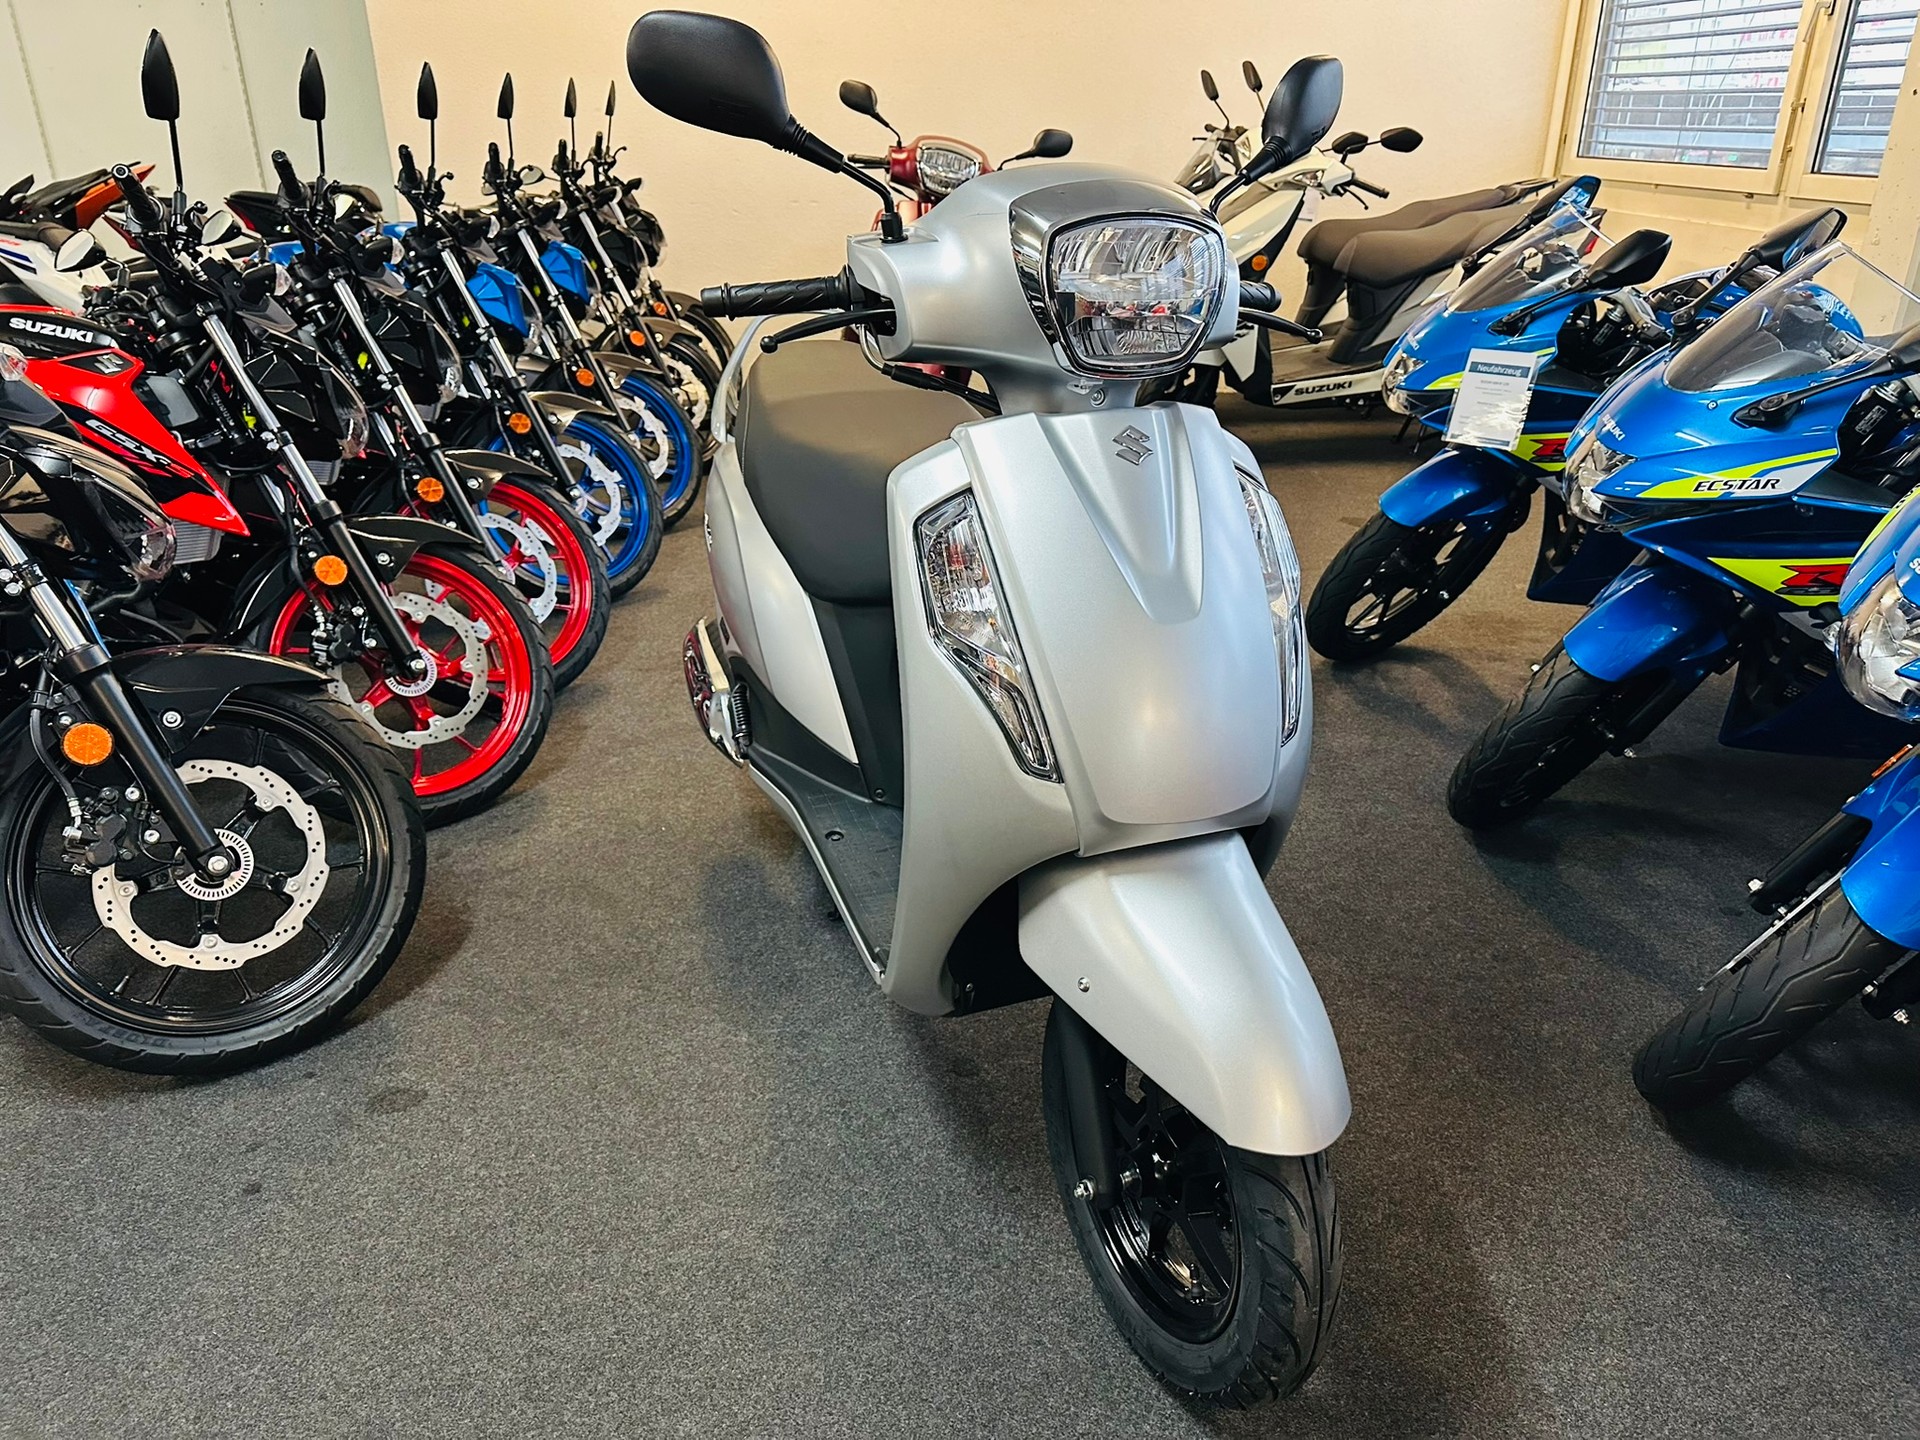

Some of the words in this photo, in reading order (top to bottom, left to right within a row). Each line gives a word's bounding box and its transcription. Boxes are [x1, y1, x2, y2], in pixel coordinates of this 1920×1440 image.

[8, 317, 94, 344] SUZUKI
[1477, 364, 1522, 377] Neufahrzeug
[1294, 381, 1353, 396] SUZUKI
[1692, 478, 1781, 492] ECSTAR
